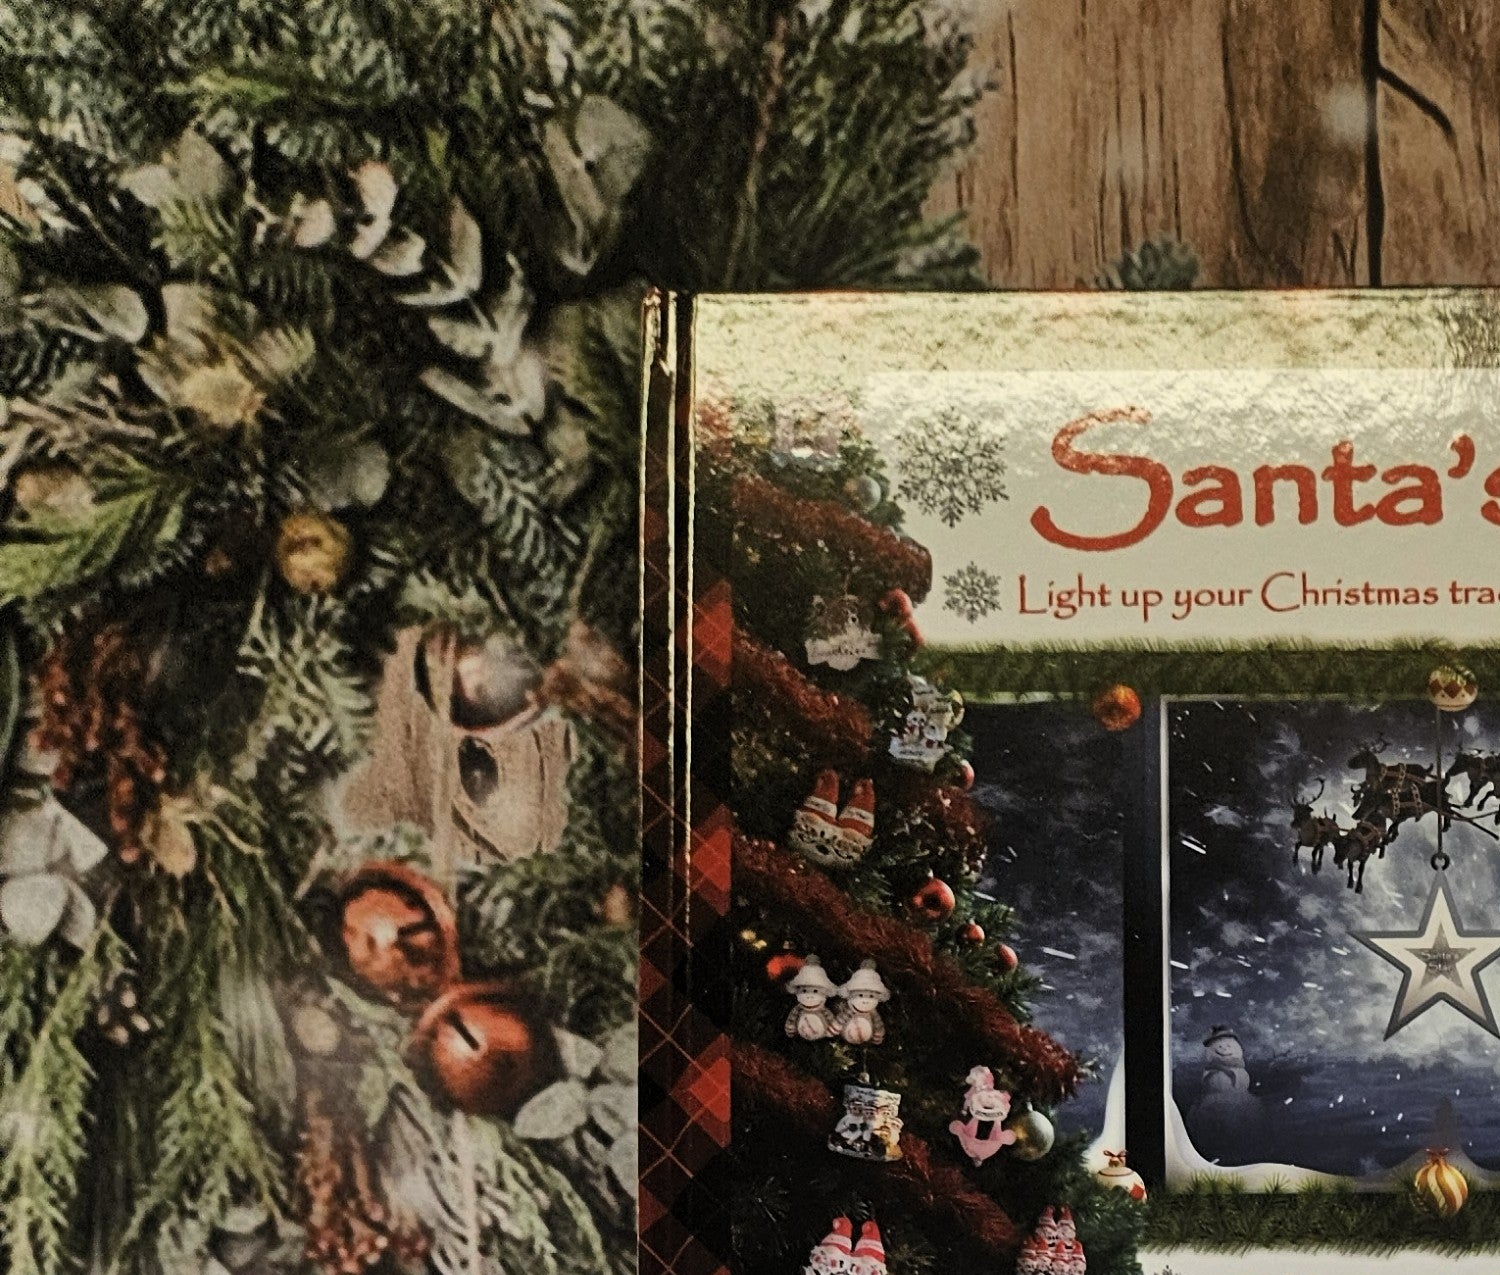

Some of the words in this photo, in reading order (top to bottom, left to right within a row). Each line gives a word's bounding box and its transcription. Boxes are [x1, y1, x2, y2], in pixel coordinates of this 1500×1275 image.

[1018, 572, 1112, 620] Light
[1120, 588, 1164, 623] up
[1171, 588, 1253, 620] your
[1260, 571, 1440, 613] Christmas
